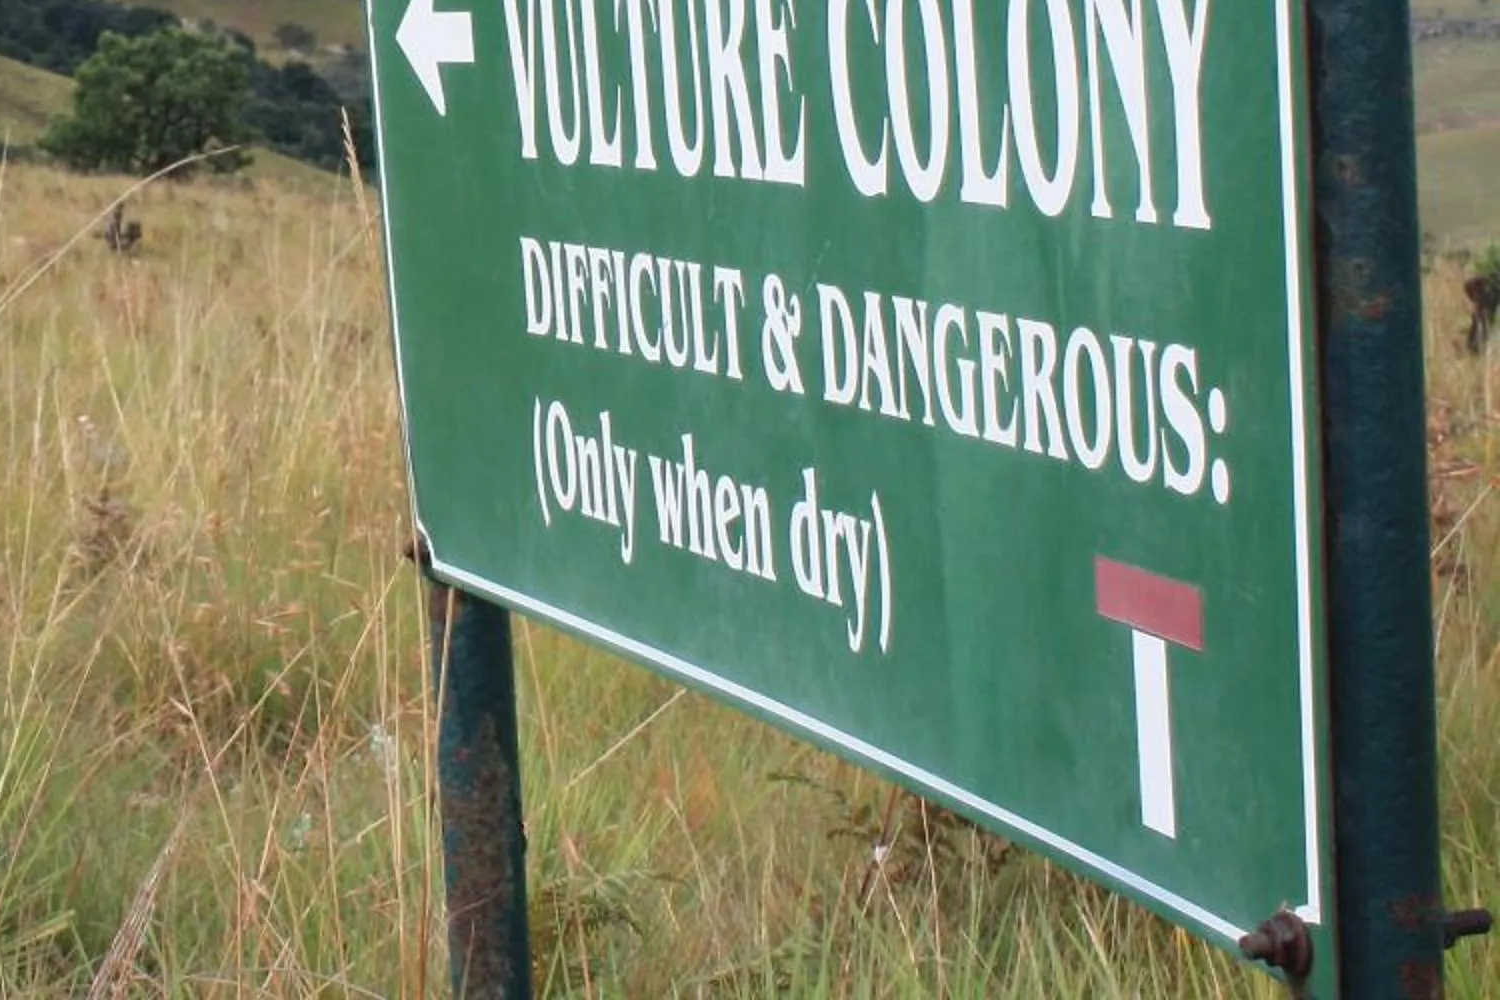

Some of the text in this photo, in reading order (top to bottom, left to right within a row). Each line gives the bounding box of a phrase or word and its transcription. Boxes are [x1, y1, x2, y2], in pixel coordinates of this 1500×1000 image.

[519, 236, 1230, 505] DIFFICULT & DANGEROUS:
[533, 397, 891, 653] (Only when dry)
